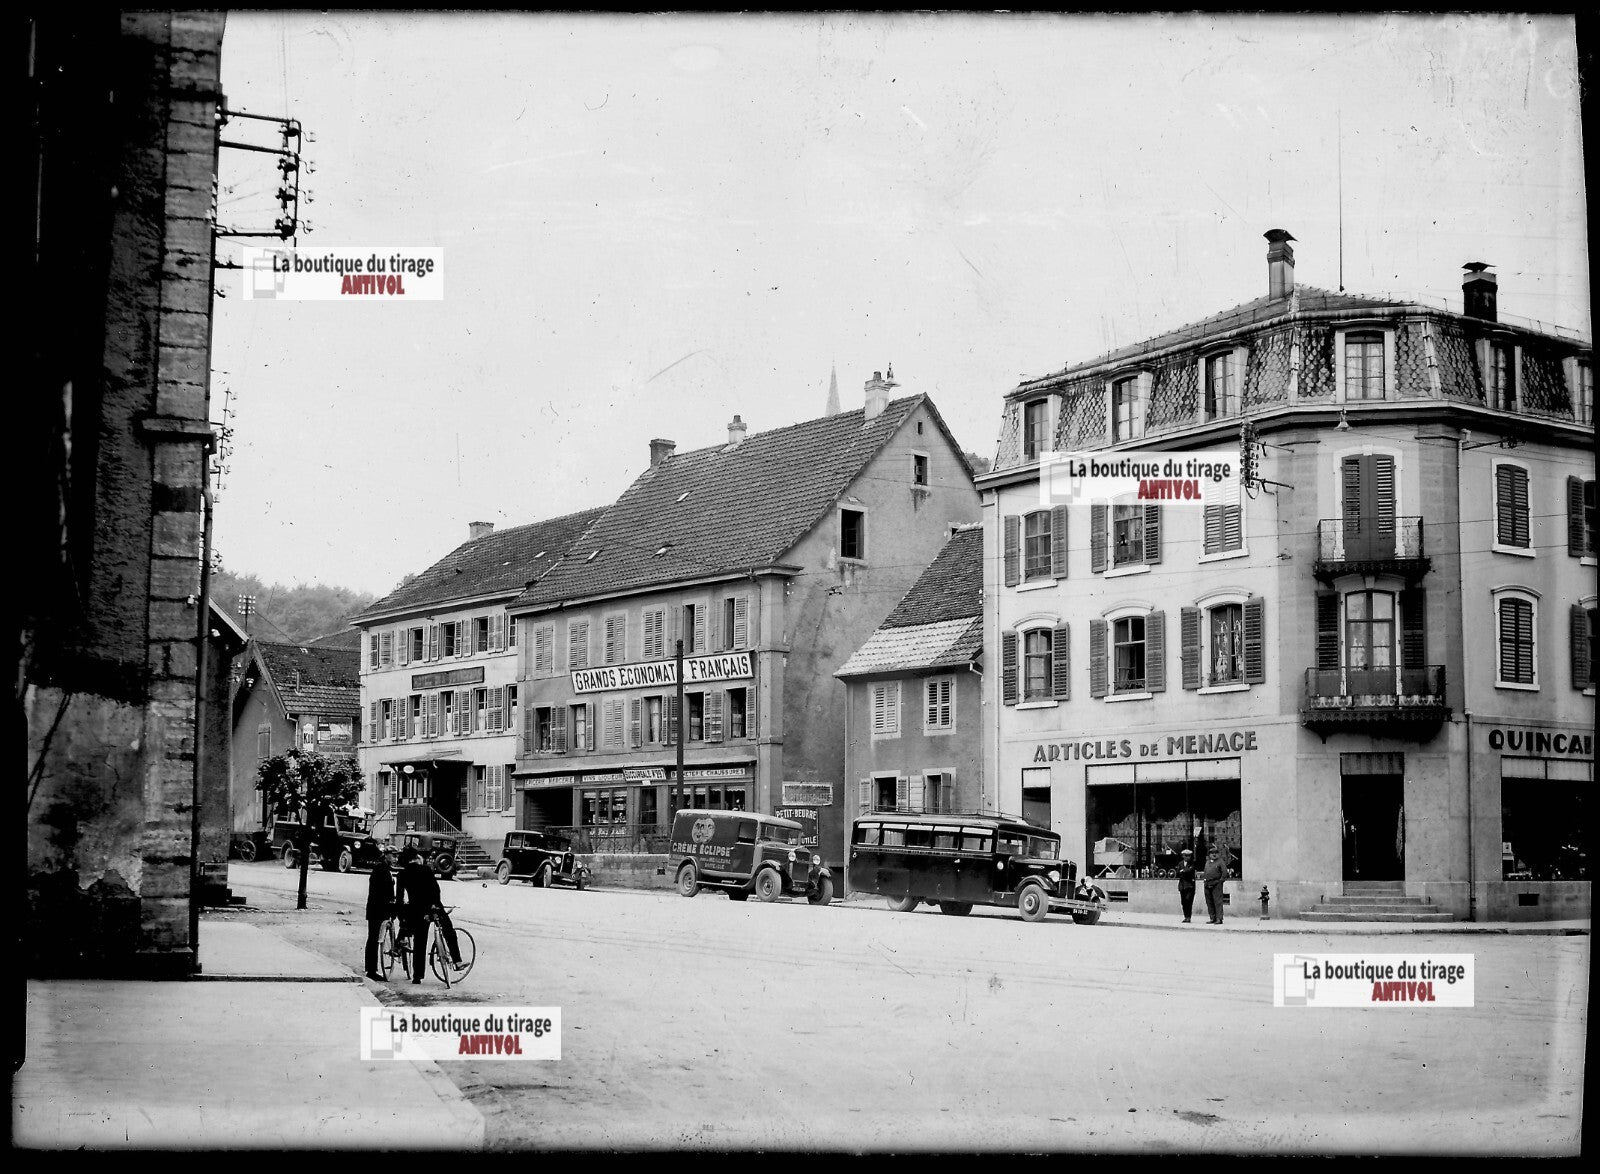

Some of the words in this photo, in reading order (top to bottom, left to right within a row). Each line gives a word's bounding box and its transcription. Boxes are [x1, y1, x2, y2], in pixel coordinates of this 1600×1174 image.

[575, 669, 617, 691] GRANDS
[688, 655, 750, 681] FRANÇAIS
[1033, 739, 1131, 762] ARTICLES
[1166, 730, 1259, 755] MENAGE
